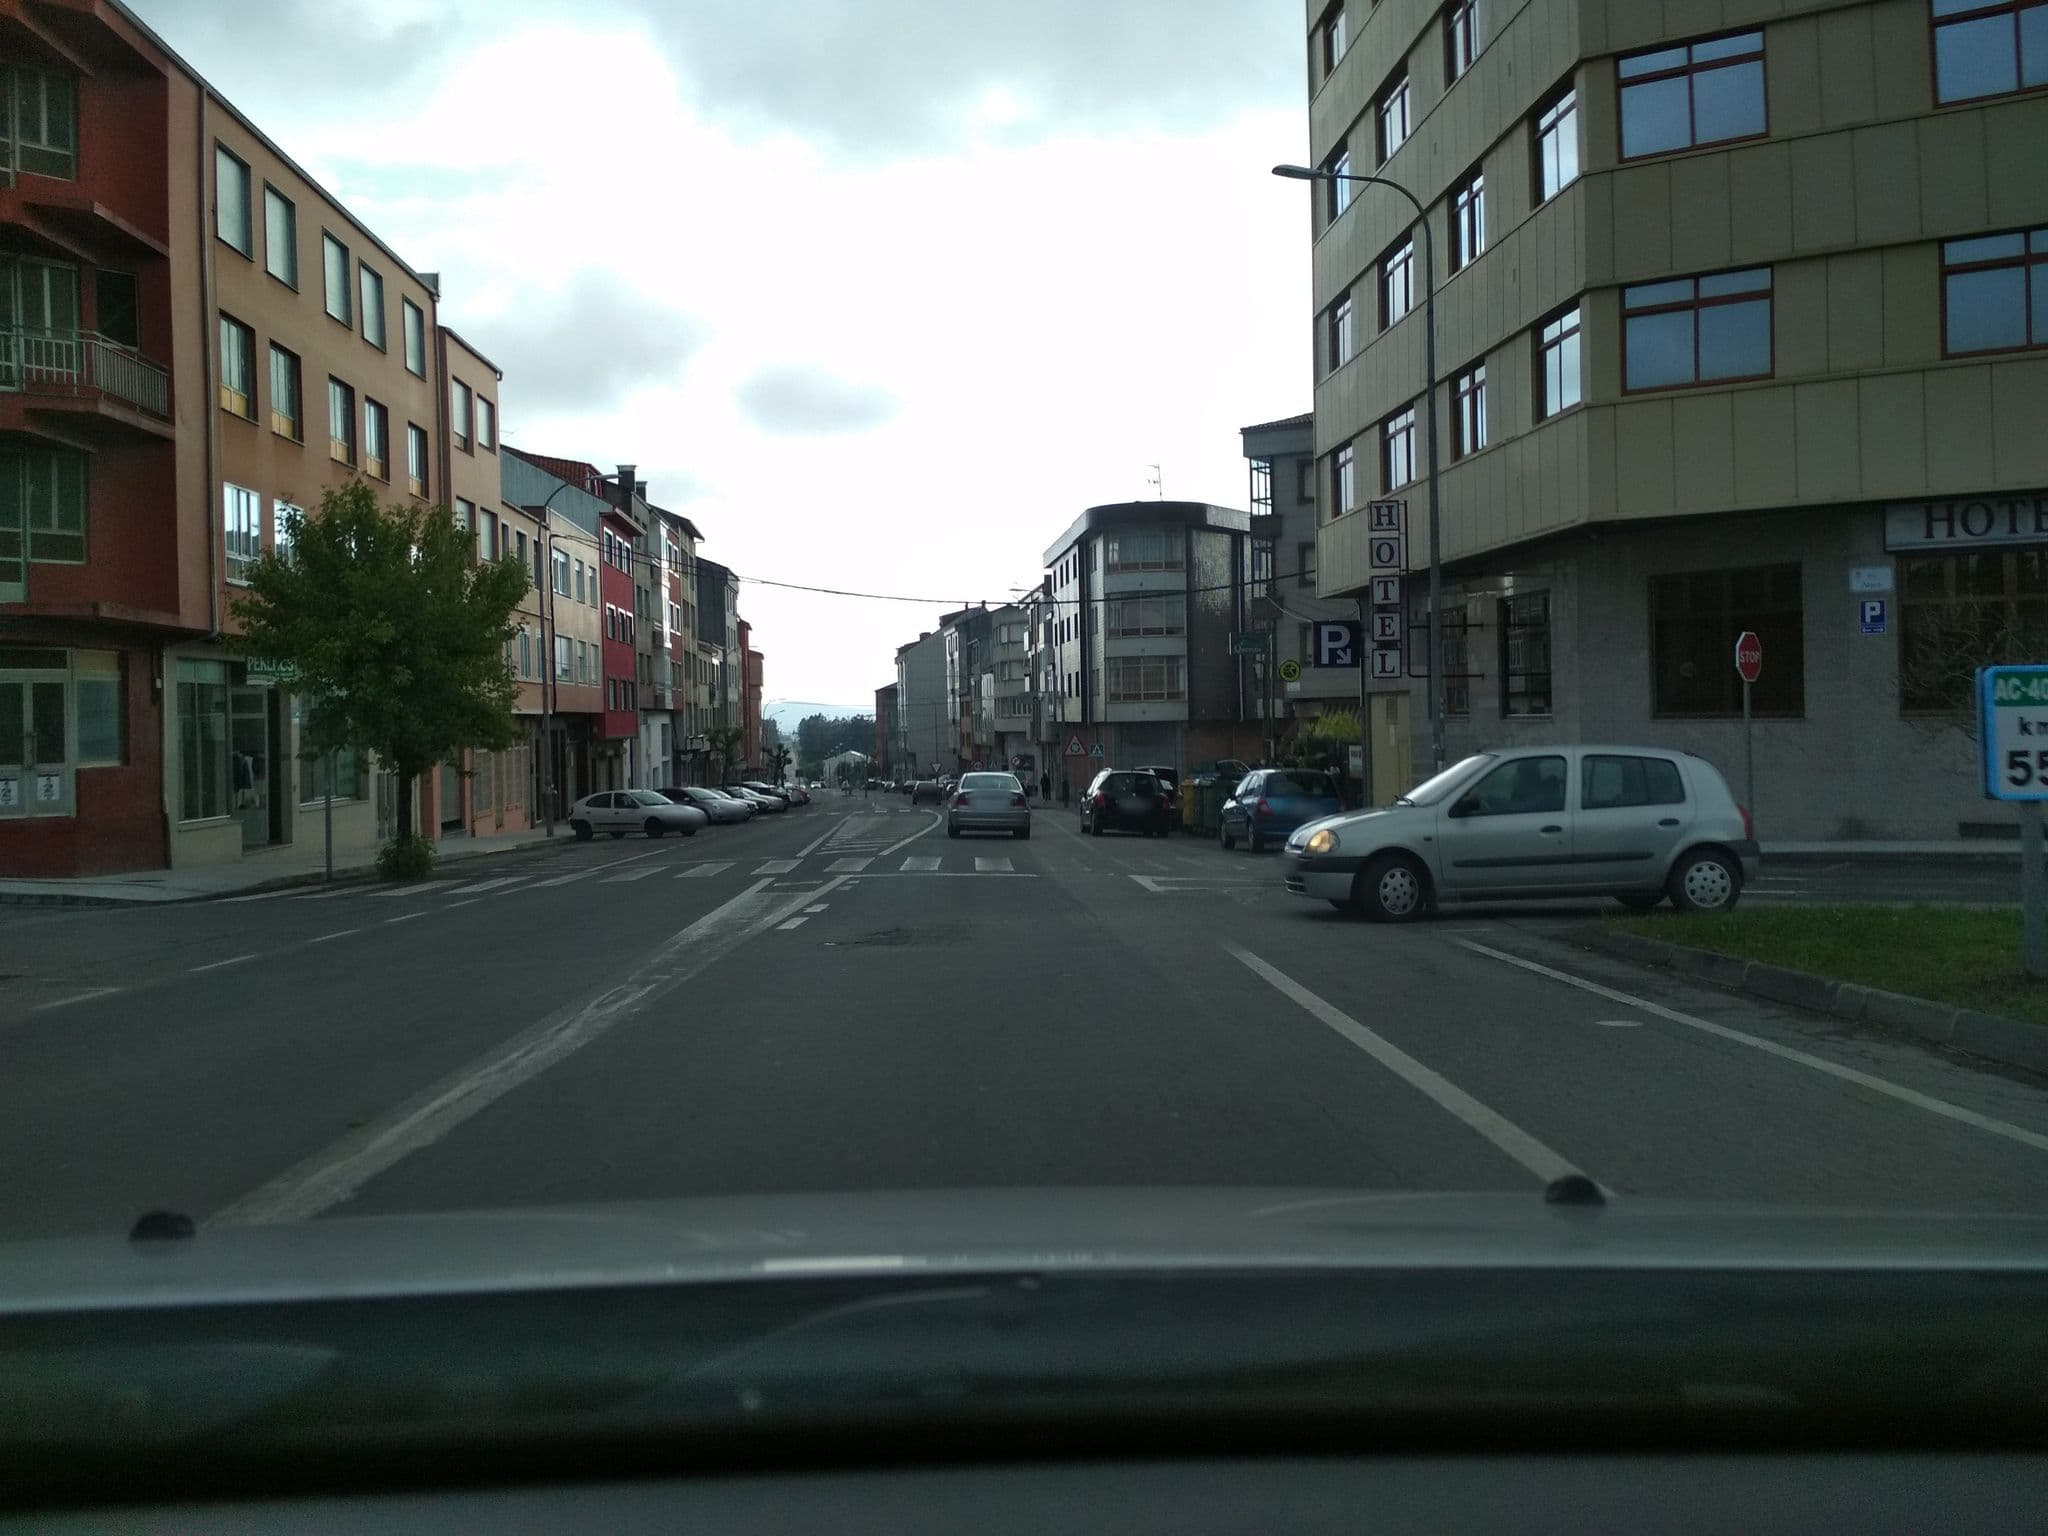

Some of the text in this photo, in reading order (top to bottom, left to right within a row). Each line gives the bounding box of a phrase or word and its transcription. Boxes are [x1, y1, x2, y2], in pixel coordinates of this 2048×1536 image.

[1374, 505, 1397, 674] HOTEL
[1864, 602, 1881, 623] P
[1320, 625, 1351, 664] P
[1740, 651, 1760, 663] STOP
